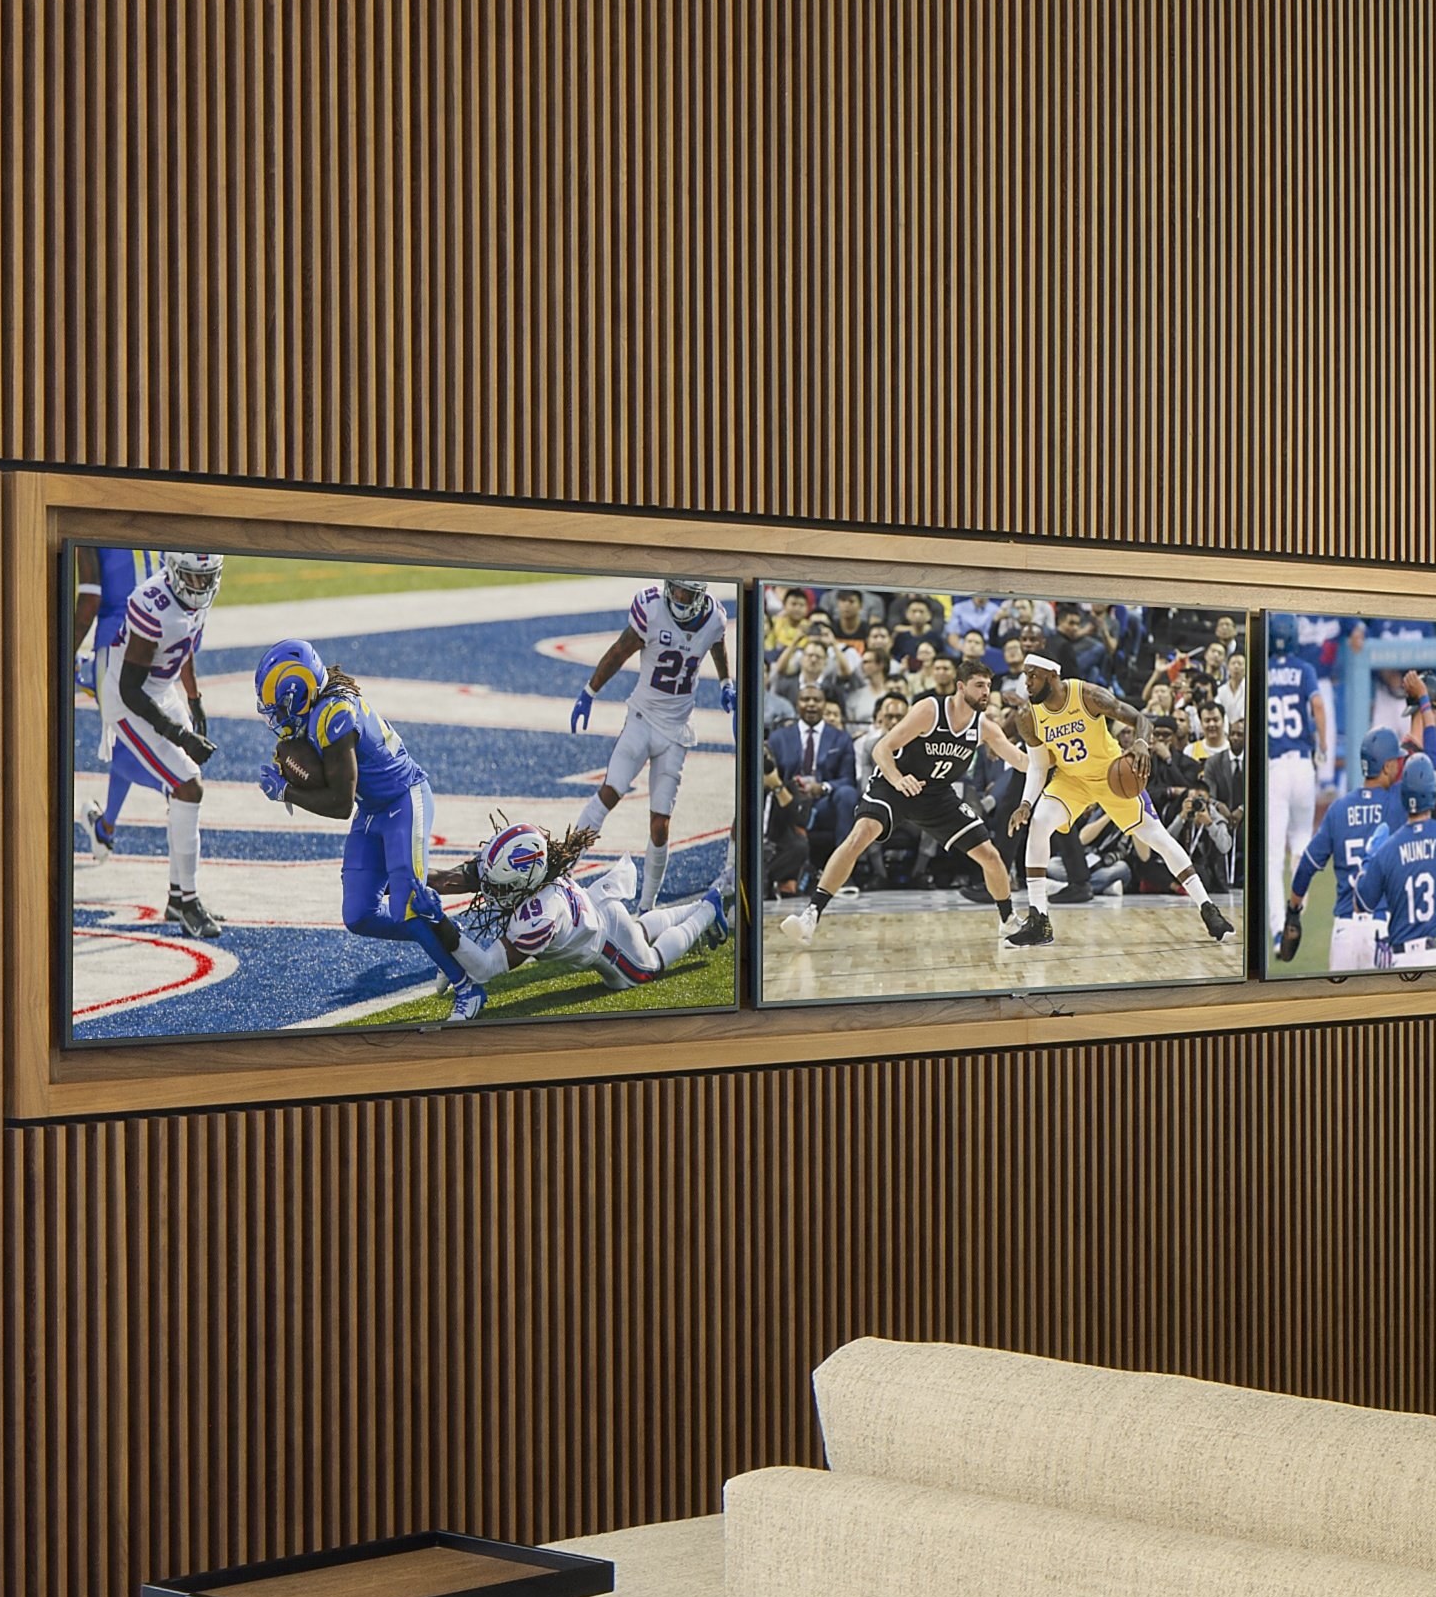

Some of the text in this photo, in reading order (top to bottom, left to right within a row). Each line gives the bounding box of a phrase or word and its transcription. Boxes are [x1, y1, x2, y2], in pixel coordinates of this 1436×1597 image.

[143, 586, 171, 611] 39
[650, 650, 701, 695] 21
[1268, 694, 1303, 739] 95
[1044, 719, 1086, 743] LAKERS
[924, 742, 974, 761] BROOKLYN
[1056, 737, 1089, 763] 23
[930, 760, 953, 779] 12
[1347, 804, 1383, 826] BETTS
[1399, 839, 1436, 865] MUNCY
[519, 898, 543, 921] 49
[1405, 872, 1435, 924] 13
